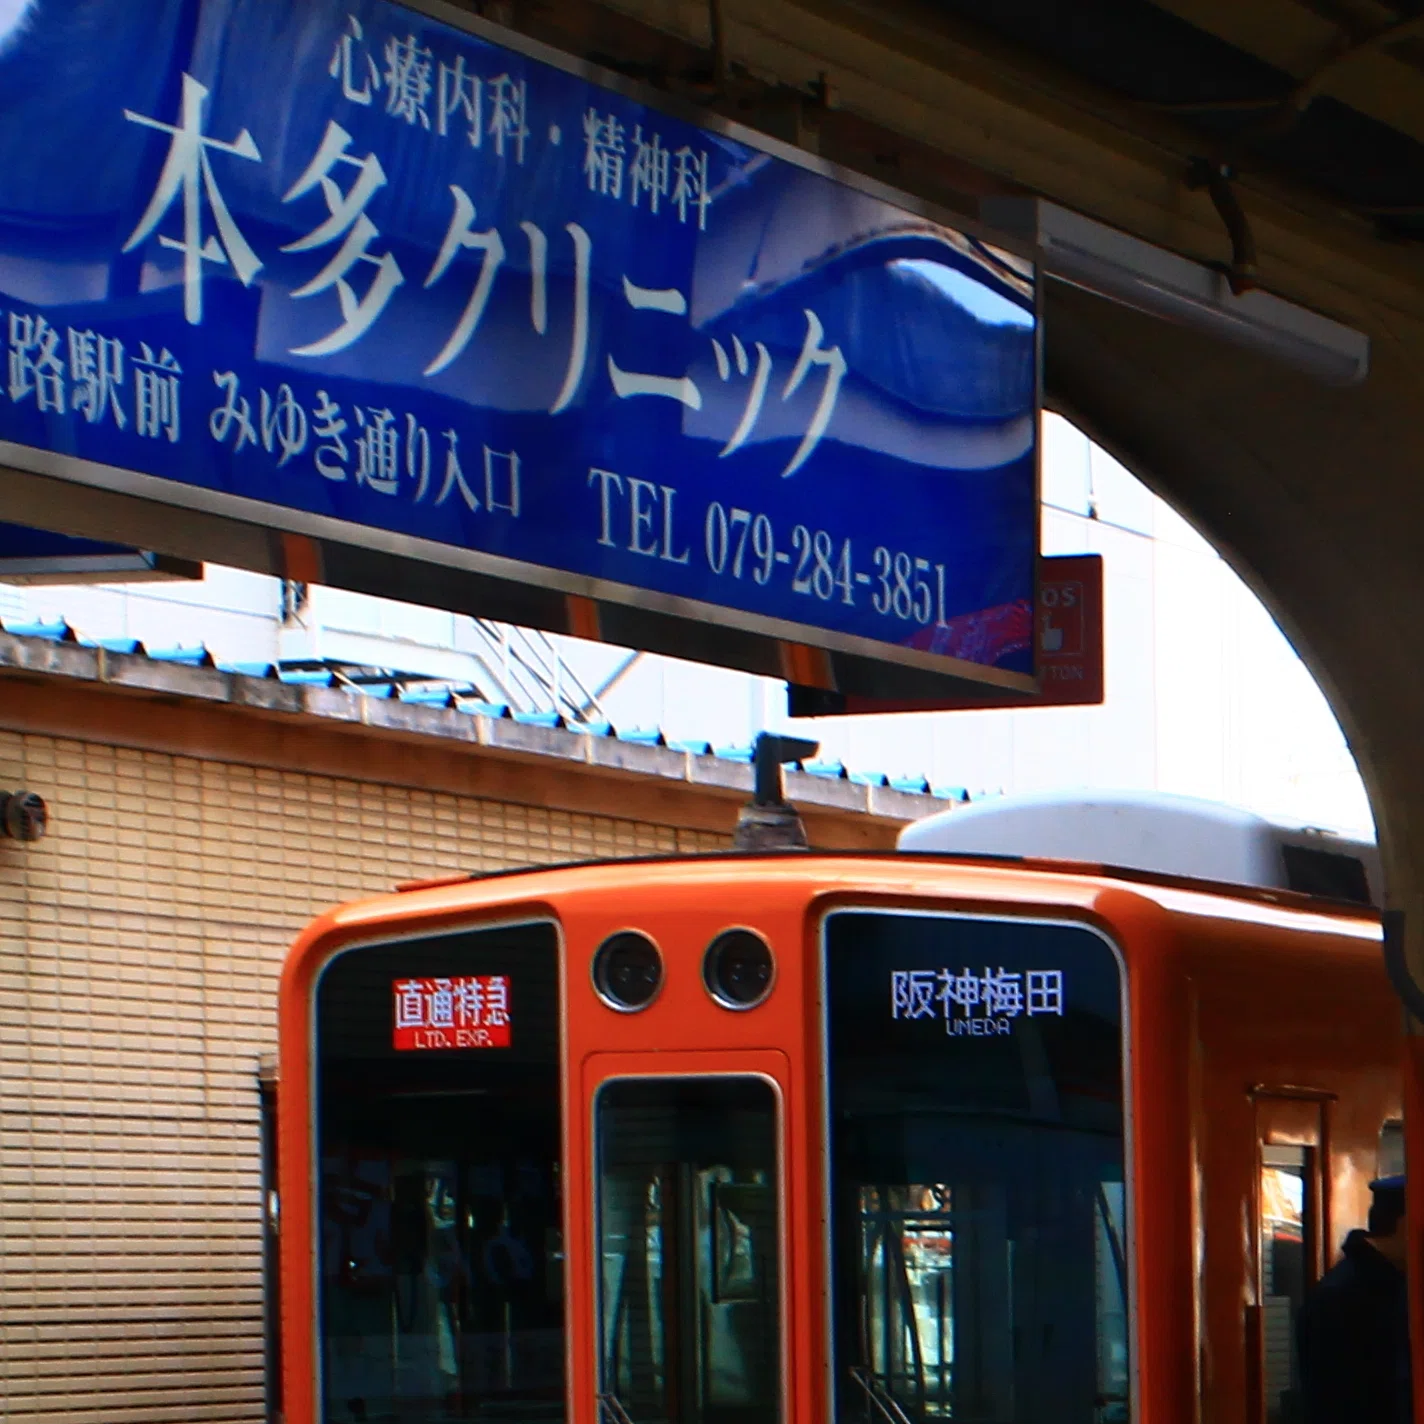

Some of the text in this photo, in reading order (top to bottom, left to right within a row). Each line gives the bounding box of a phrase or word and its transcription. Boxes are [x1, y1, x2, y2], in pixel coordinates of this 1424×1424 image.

[123, 73, 849, 479] 本多クリニック
[0, 312, 522, 519] 路駅前 みゆき通り入口
[589, 466, 949, 629] TEL 079-284-3851
[1041, 587, 1076, 607] OS
[395, 966, 1063, 1029] 直通特急 阪神梅田
[415, 1030, 452, 1049] LTD.
